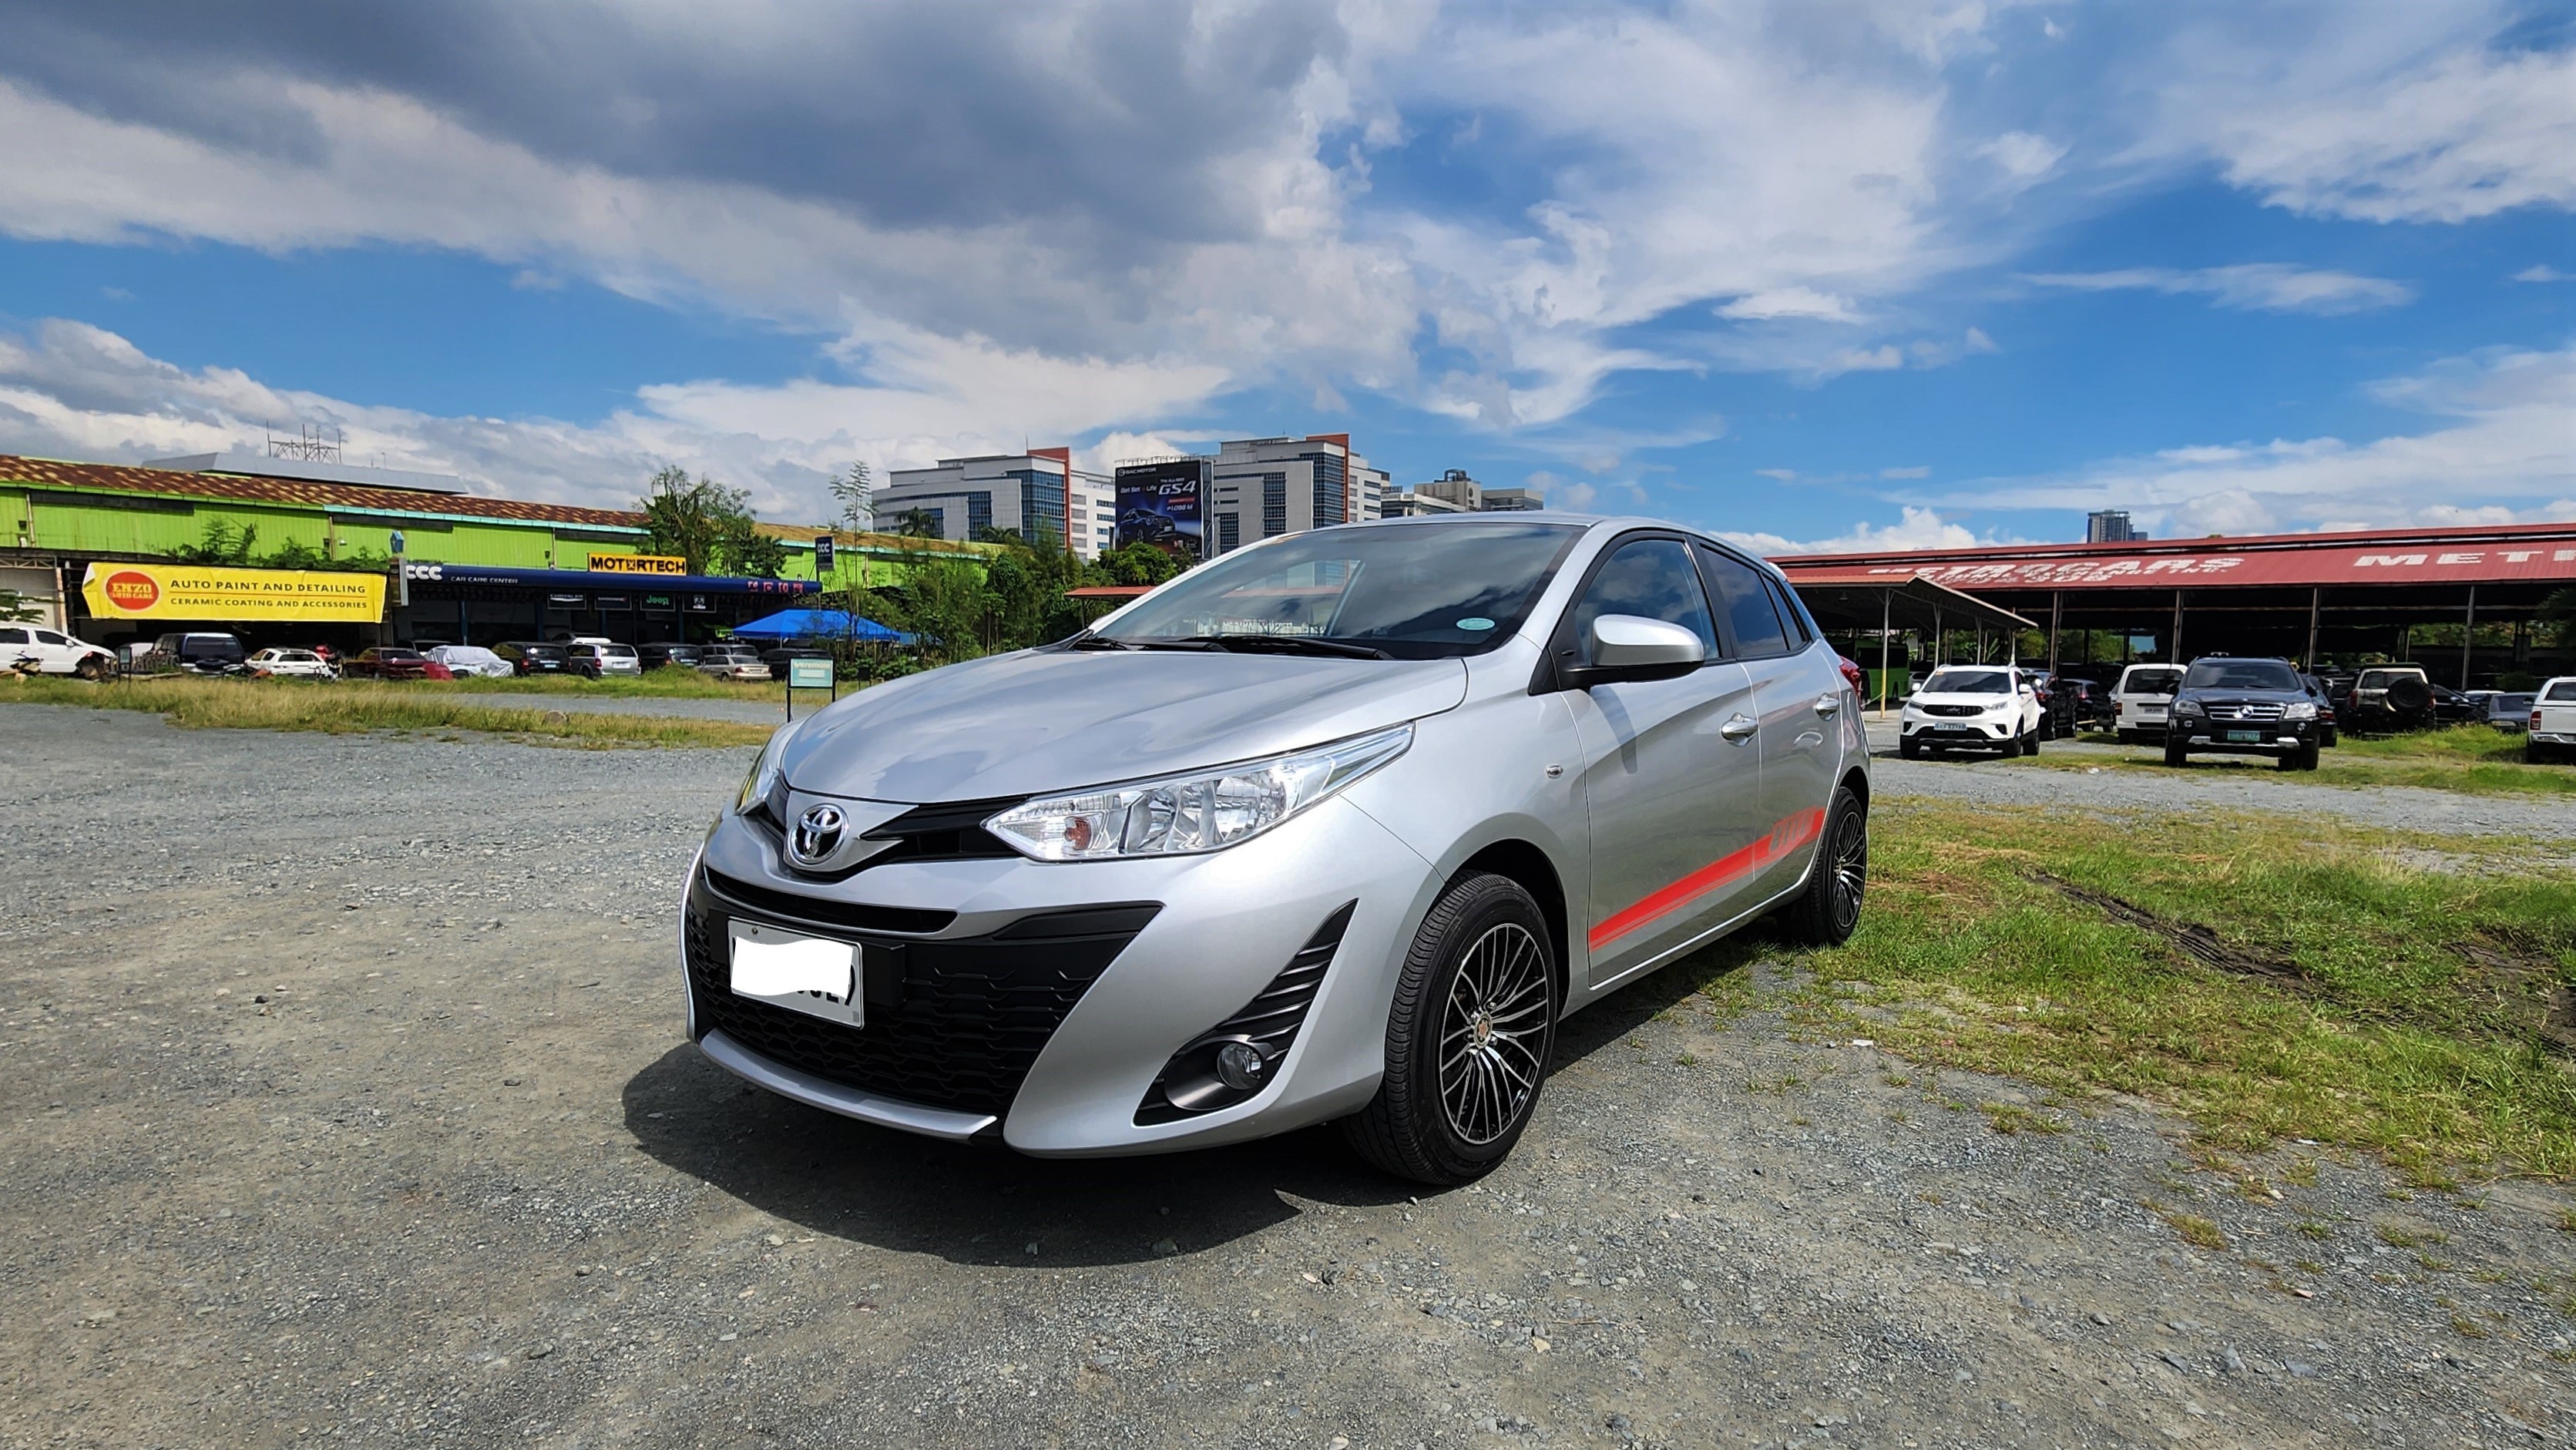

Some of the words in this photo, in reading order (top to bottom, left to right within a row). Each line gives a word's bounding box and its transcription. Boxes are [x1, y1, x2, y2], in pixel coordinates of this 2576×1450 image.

[1158, 480, 1196, 495] GS4
[591, 556, 685, 573] MOTORTECH
[1868, 558, 2244, 579] ETROCARS
[405, 565, 442, 580] CCC
[112, 582, 152, 593] ENZO
[170, 579, 211, 589] AUTO
[216, 581, 258, 591] PAINT
[263, 582, 293, 592] AND
[297, 583, 366, 593] DETAILING
[224, 599, 273, 607] COATING
[646, 595, 669, 606] Jeep
